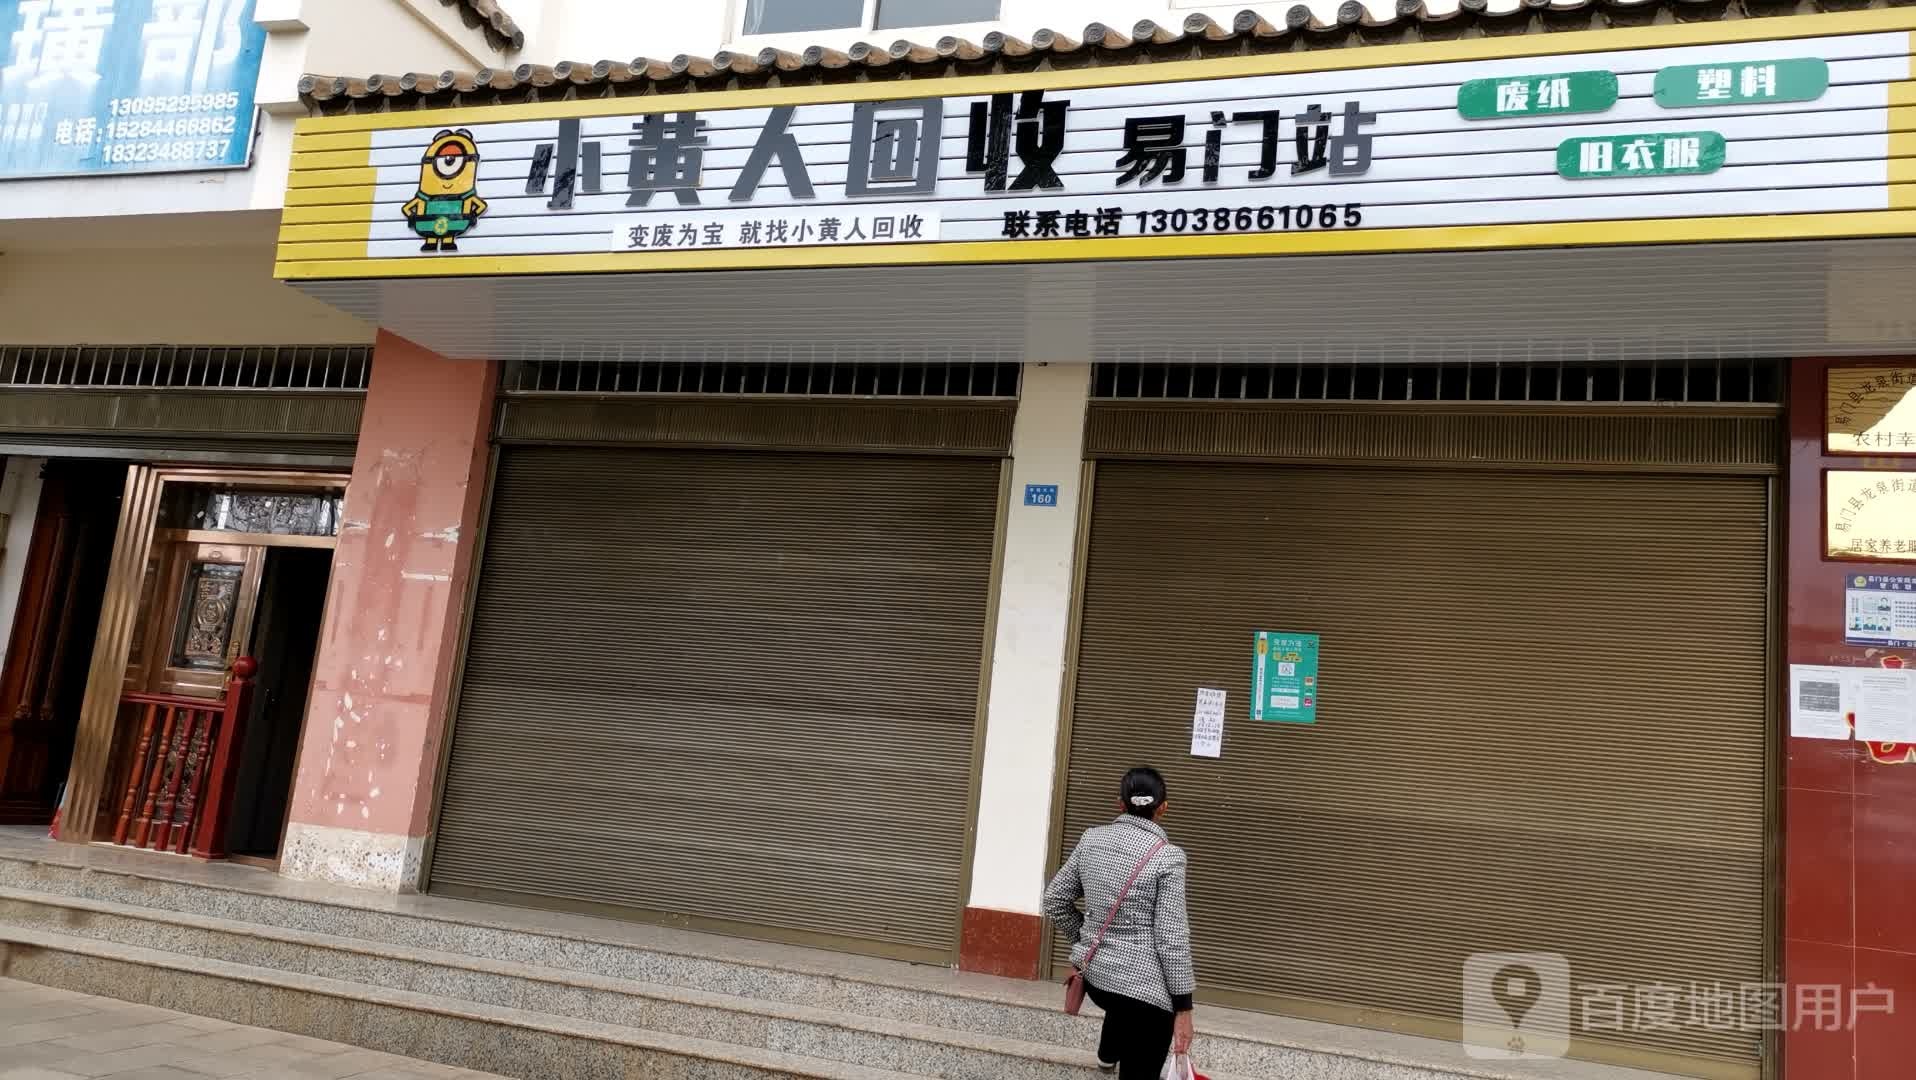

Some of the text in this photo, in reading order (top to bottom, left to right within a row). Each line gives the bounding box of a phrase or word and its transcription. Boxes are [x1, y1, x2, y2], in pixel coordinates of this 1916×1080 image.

[1496, 77, 1572, 113] 废纸
[1696, 65, 1776, 100] 塑料
[524, 89, 1377, 209] 小黄人回收 易门站
[1578, 138, 1701, 173] 旧衣服
[627, 214, 924, 249] 变废为宝 就找小黄人回收
[1002, 203, 1363, 238] 联系电话 13038661065
[1031, 494, 1052, 504] 160
